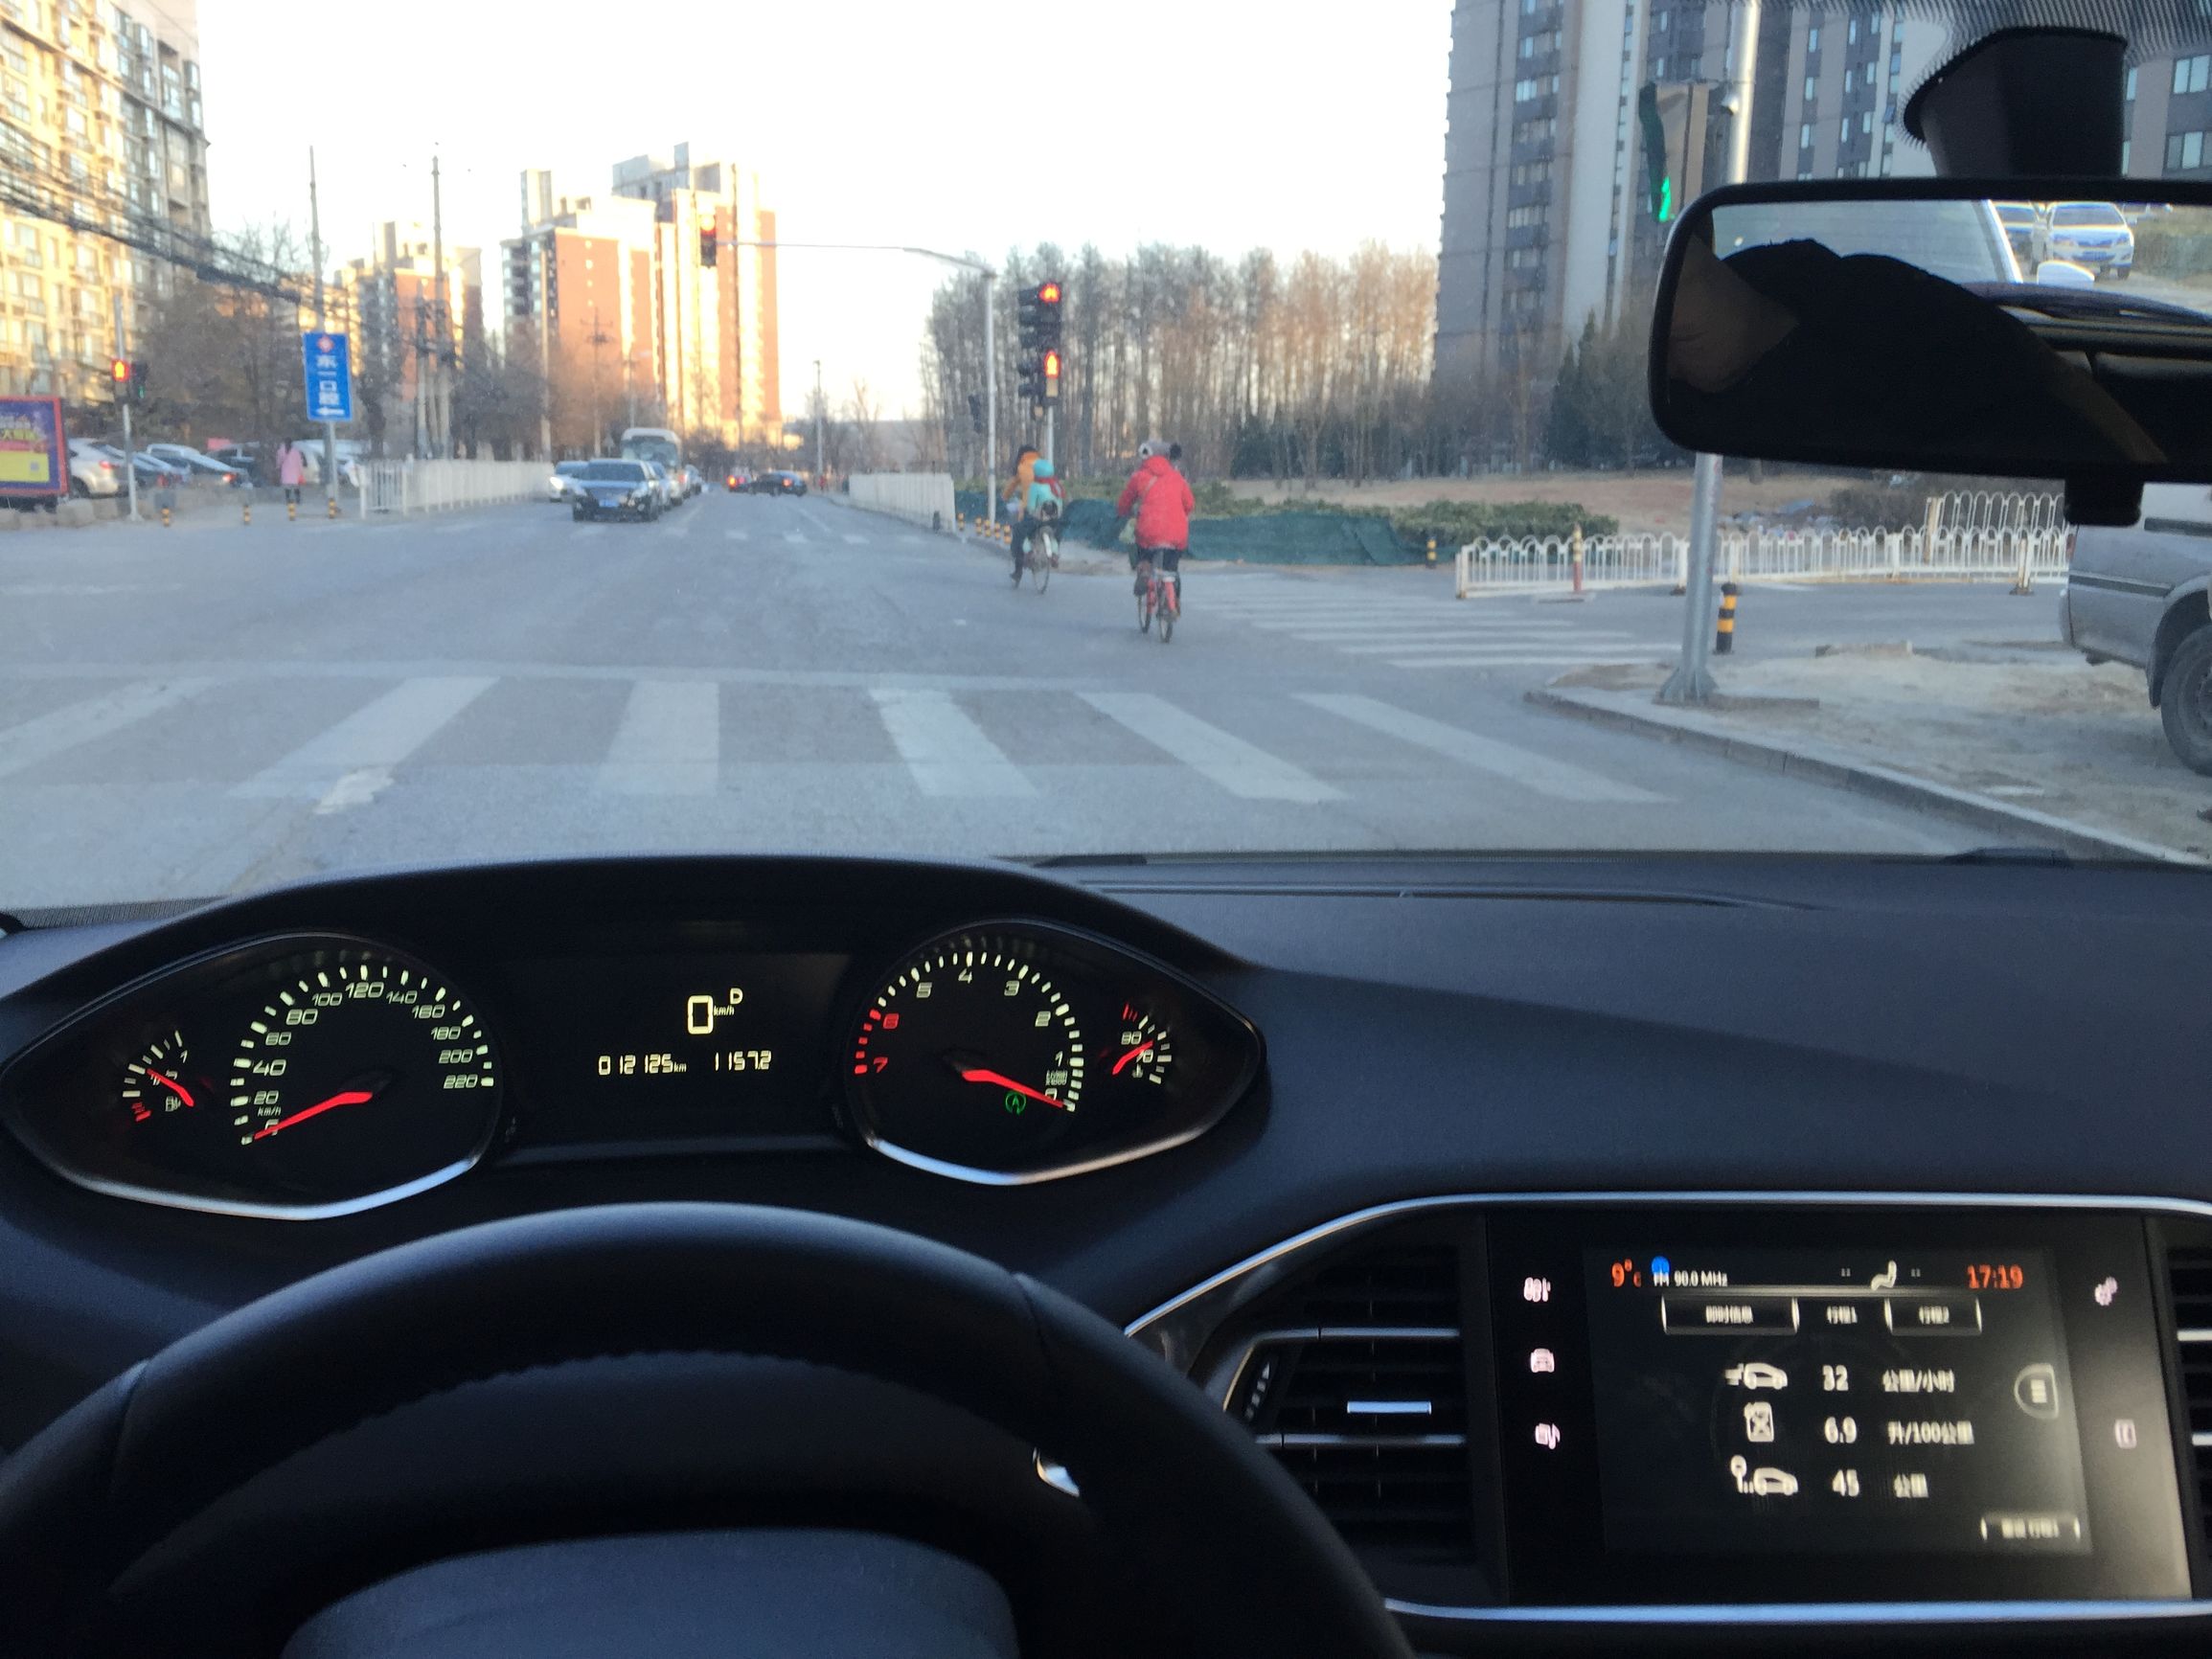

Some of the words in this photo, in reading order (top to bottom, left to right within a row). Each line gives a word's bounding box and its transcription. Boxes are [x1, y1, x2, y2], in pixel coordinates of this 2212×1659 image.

[958, 968, 972, 984] 4
[345, 982, 385, 998] 120
[916, 982, 932, 998] 5
[1004, 981, 1020, 996] 3
[311, 992, 343, 1006] 100
[386, 990, 418, 1004] 140
[285, 1009, 318, 1025] 80
[687, 994, 714, 1034] 0
[714, 1005, 735, 1016] km/h
[882, 1013, 900, 1029] 6
[1035, 1011, 1051, 1027] 2
[430, 1026, 462, 1041] 180
[180, 1050, 188, 1063] 1
[438, 1049, 473, 1064] 200
[1055, 1051, 1063, 1067] 1
[252, 1058, 286, 1077] 40
[873, 1057, 888, 1073] 7
[444, 1074, 478, 1089] 220
[254, 1090, 279, 1104] 20
[1700, 1270, 1728, 1286] MHz
[1967, 1264, 2023, 1288] 17:19
[1822, 1364, 1849, 1391] 32
